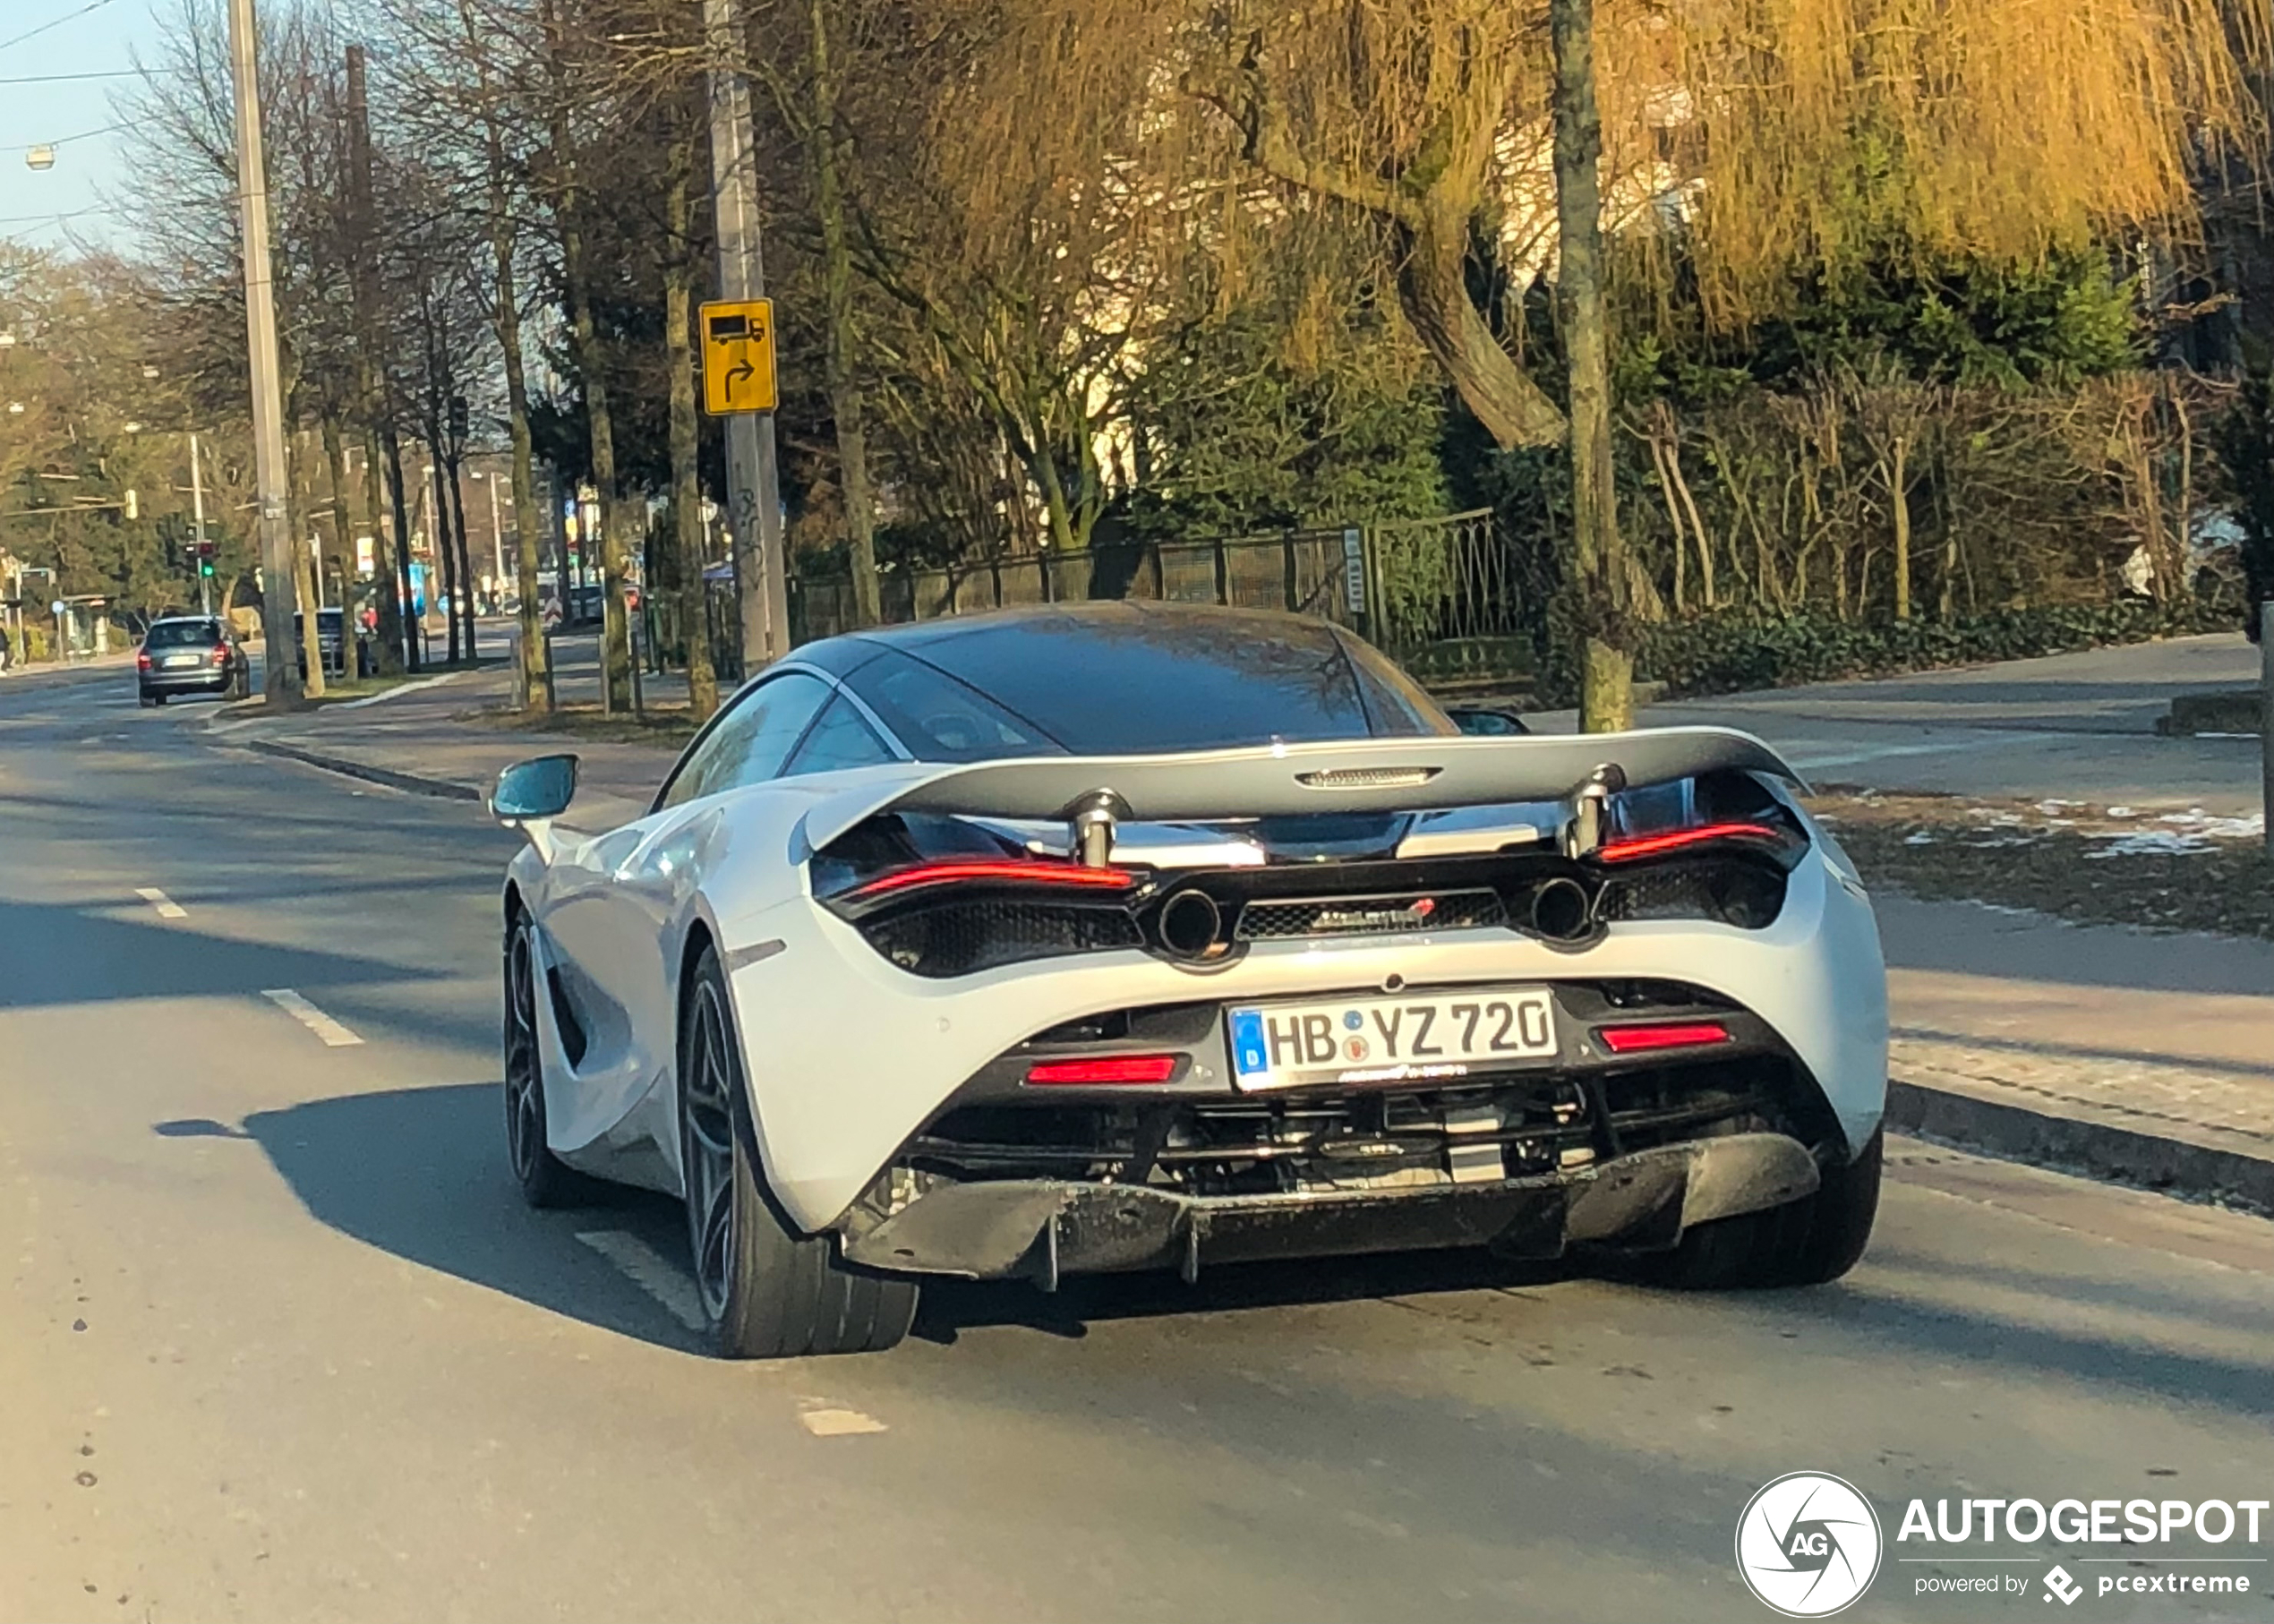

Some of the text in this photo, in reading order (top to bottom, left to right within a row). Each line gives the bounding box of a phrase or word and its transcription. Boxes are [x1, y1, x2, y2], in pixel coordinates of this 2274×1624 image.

[1268, 999, 1551, 1066] HB YZ 720
[1245, 1048, 1261, 1066] D
